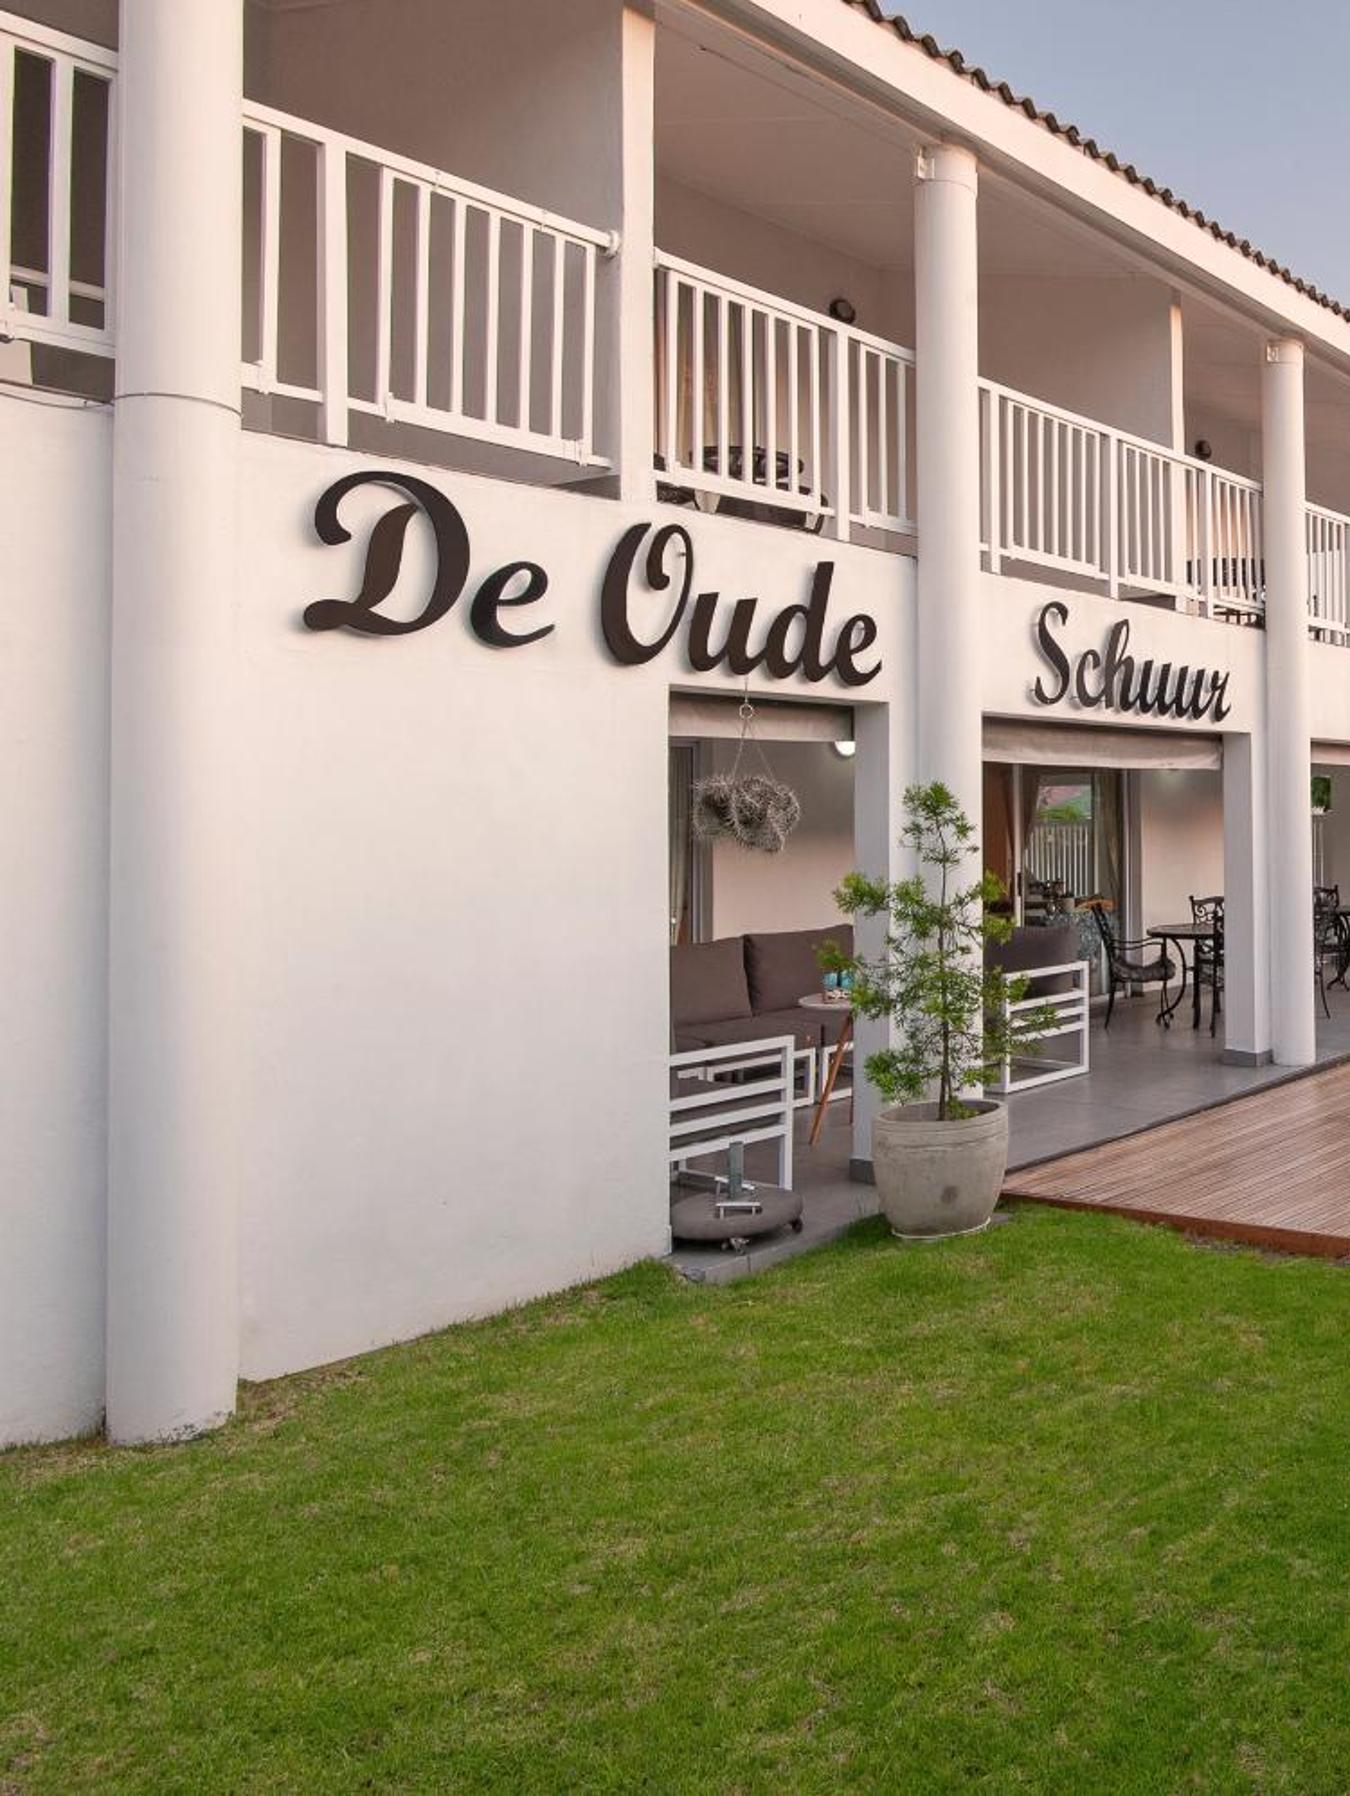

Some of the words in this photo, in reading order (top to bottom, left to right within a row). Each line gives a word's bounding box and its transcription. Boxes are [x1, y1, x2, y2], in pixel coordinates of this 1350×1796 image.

[303, 470, 556, 648] De
[601, 522, 882, 687] Oude
[1034, 601, 1231, 722] Schuur
